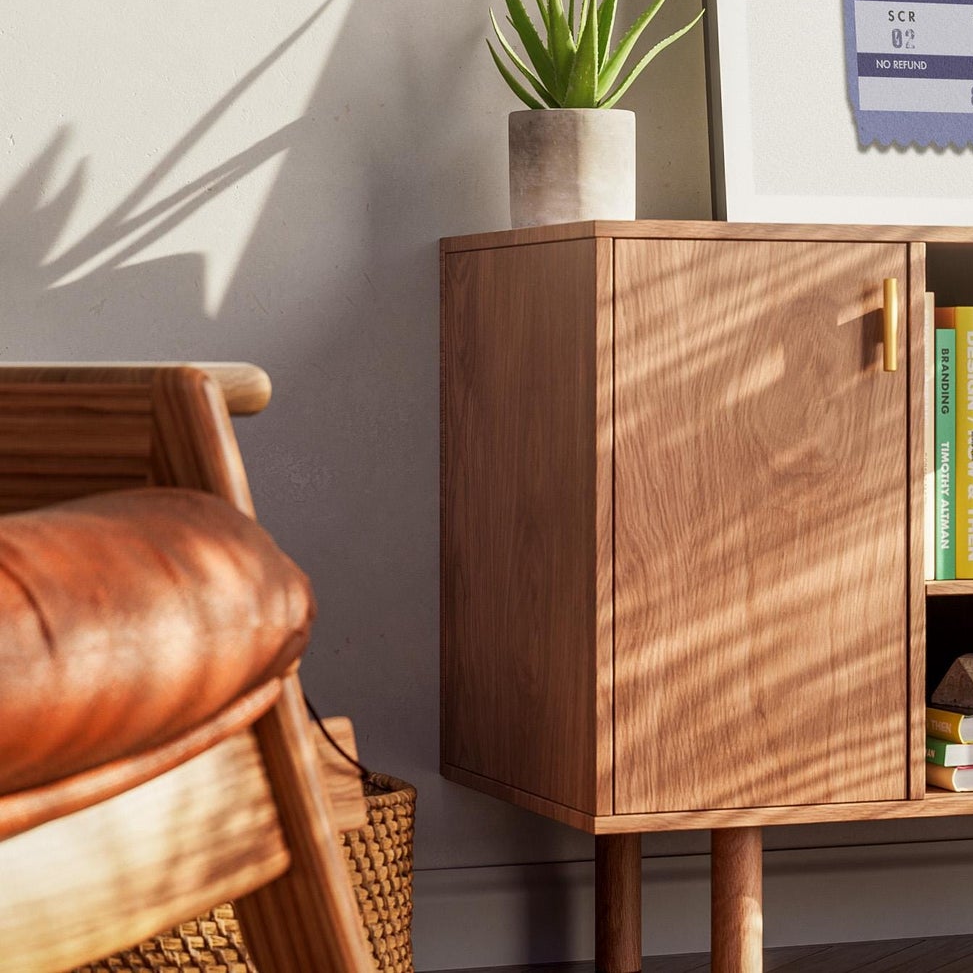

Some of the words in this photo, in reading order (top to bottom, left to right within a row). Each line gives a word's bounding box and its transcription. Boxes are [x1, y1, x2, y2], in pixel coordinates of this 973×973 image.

[888, 10, 916, 23] SCR
[891, 28, 916, 49] 02
[875, 59, 891, 69] NO
[893, 60, 927, 70] REFUND
[941, 348, 950, 415] BRANDING
[941, 441, 950, 496] TIMOTHY
[941, 498, 950, 549] ALTMAN
